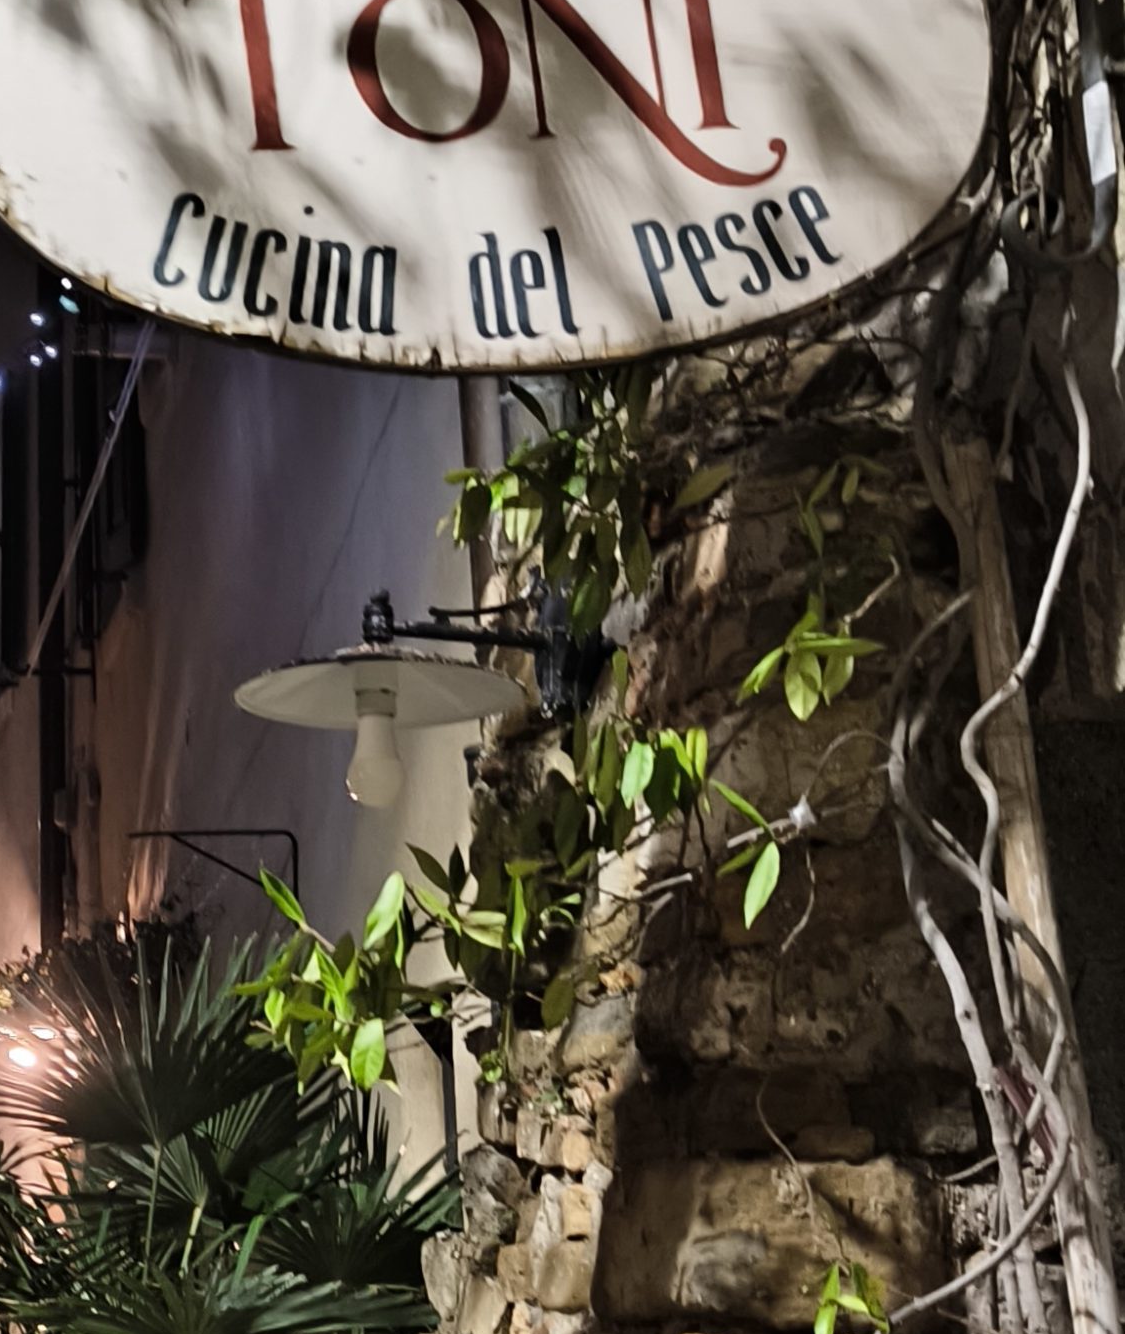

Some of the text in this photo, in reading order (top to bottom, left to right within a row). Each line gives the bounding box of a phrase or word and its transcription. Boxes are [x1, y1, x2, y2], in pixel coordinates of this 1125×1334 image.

[152, 185, 844, 339] Cucina del Pesce
